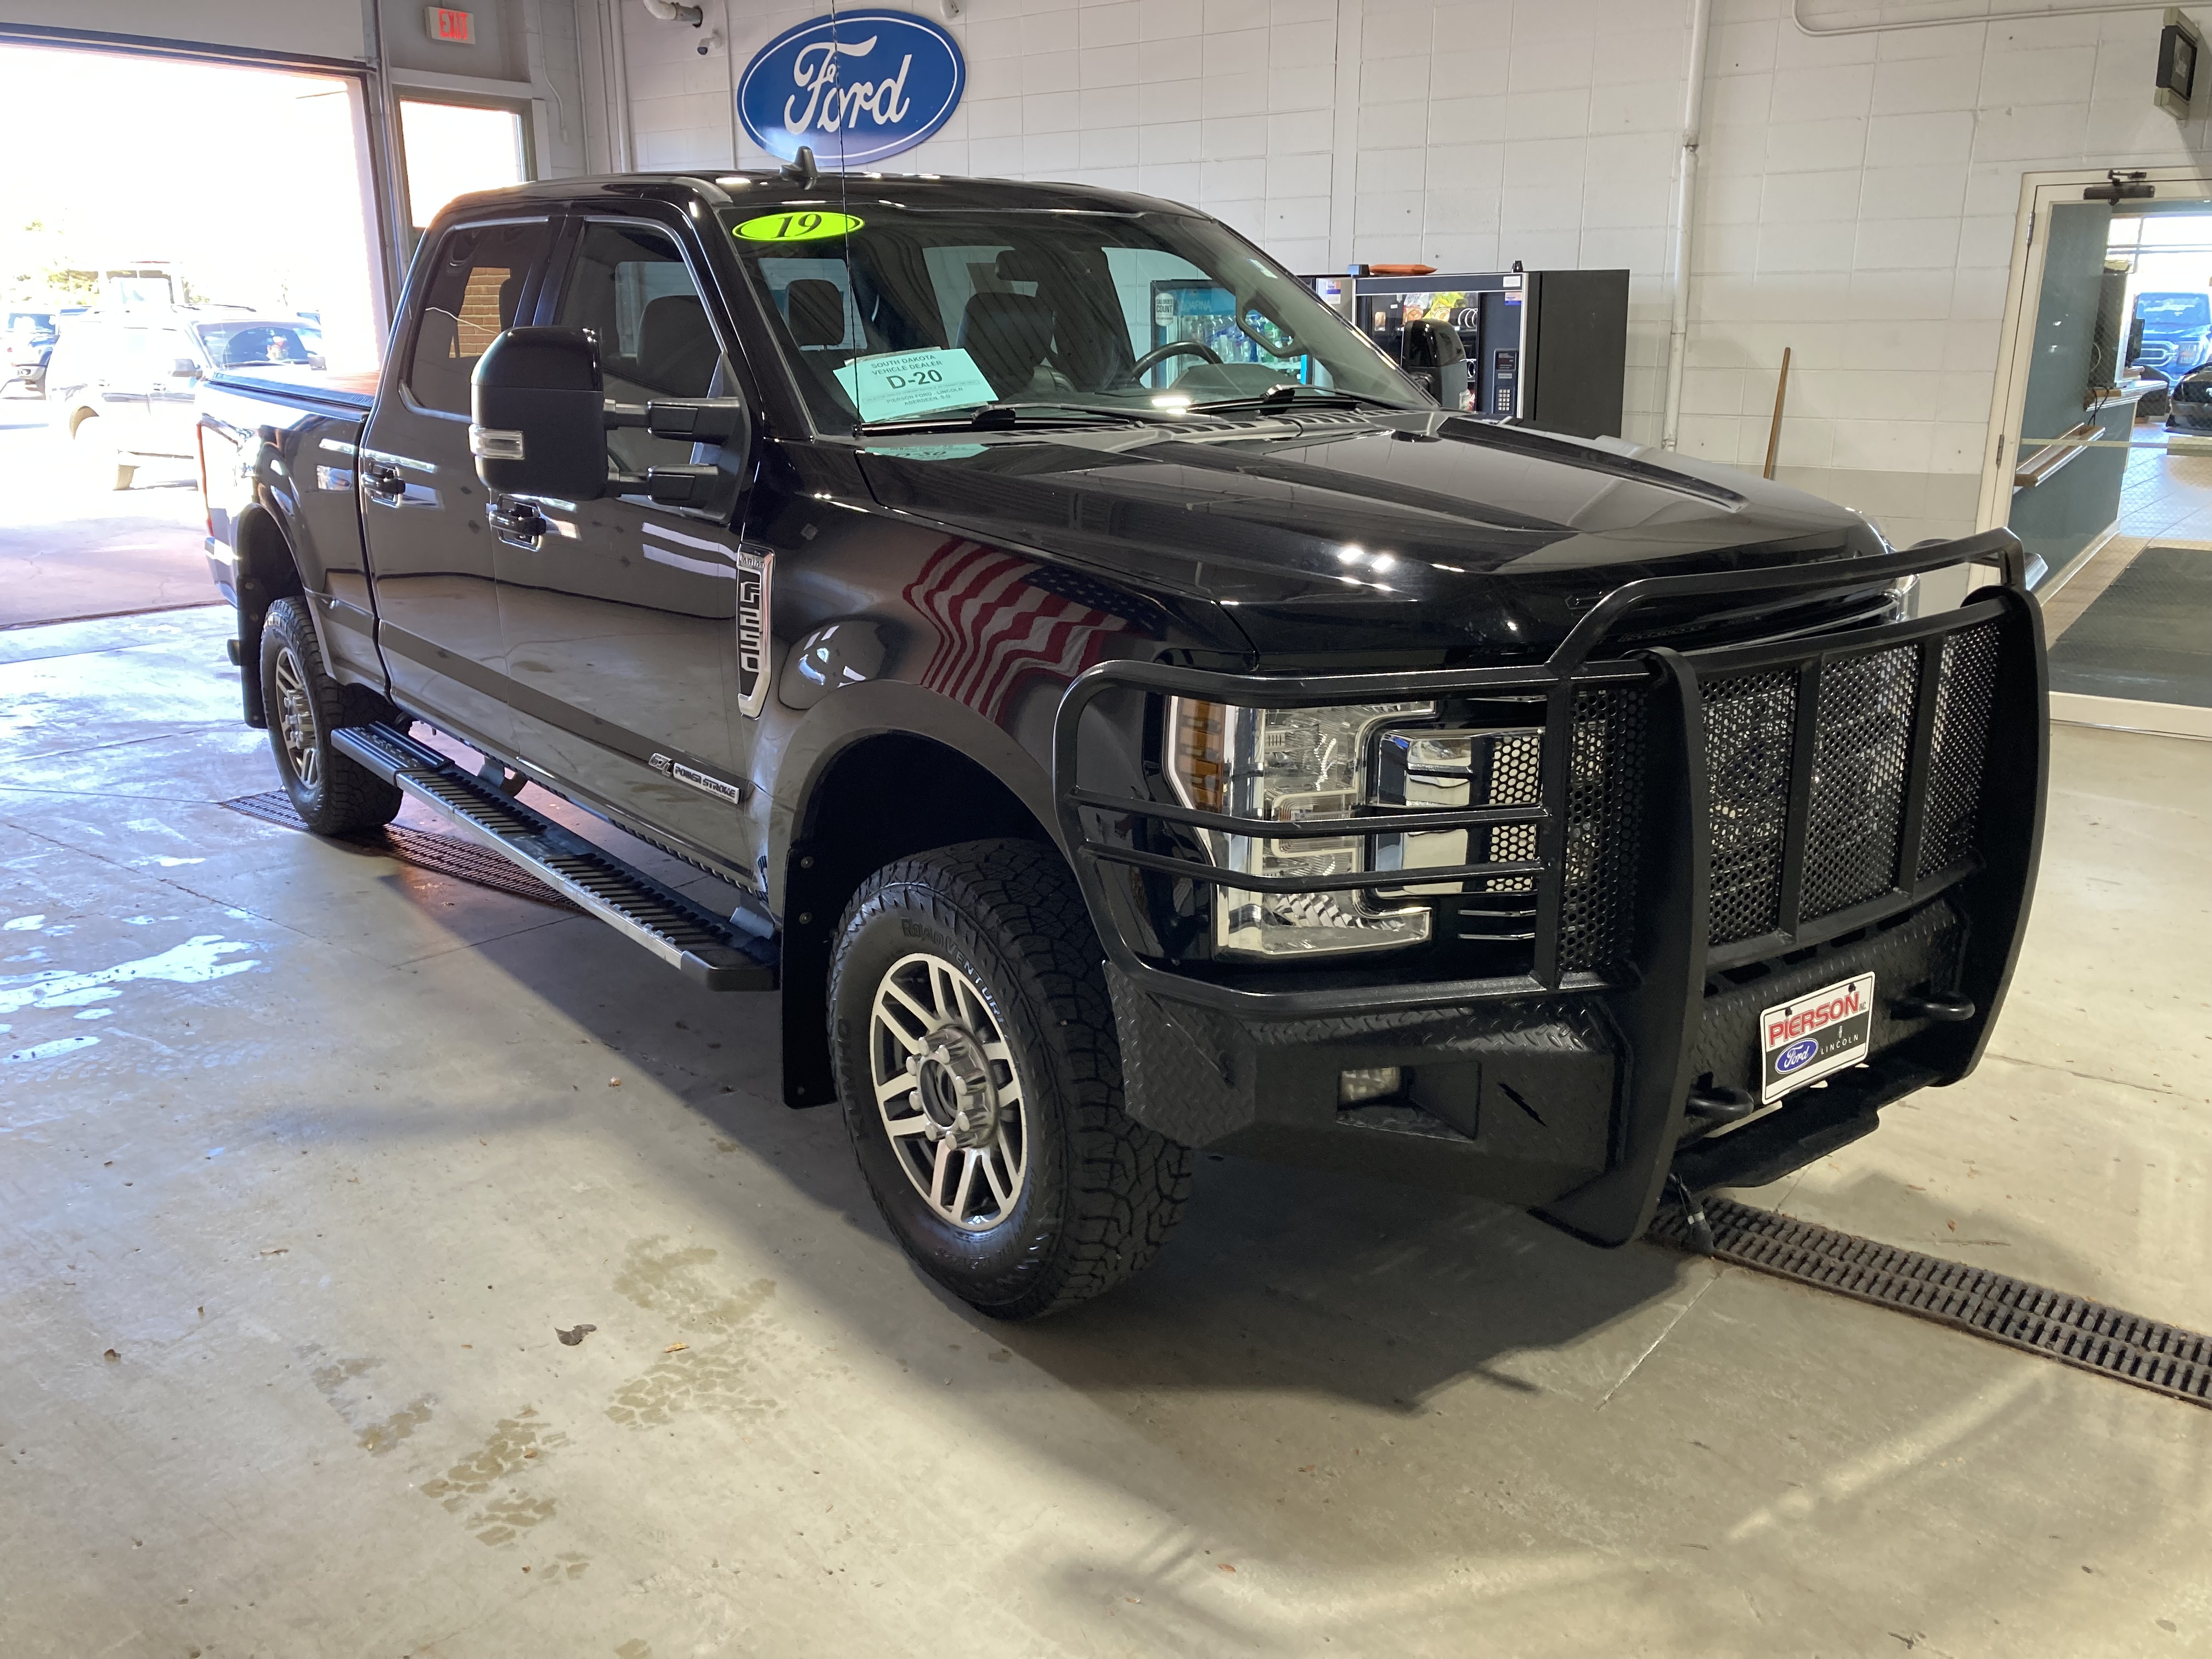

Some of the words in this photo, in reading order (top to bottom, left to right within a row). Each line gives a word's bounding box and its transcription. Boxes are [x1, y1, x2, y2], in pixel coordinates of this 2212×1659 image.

[439, 9, 467, 40] EXIT
[784, 35, 912, 134] Ford
[770, 213, 822, 239] 19
[871, 360, 900, 368] SOUTH
[901, 355, 936, 363] DAKOTA
[872, 365, 908, 375] VEHICLE
[909, 360, 943, 369] DEALER
[886, 370, 943, 389] D-20
[887, 394, 914, 403] PIERSON
[740, 552, 764, 568] LARIAT
[675, 766, 702, 785] POWER
[703, 778, 736, 798] STROKE
[1769, 991, 1859, 1047] PIERSON
[1820, 1034, 1859, 1055] LINCOLN
[1784, 1045, 1810, 1068] Ford
